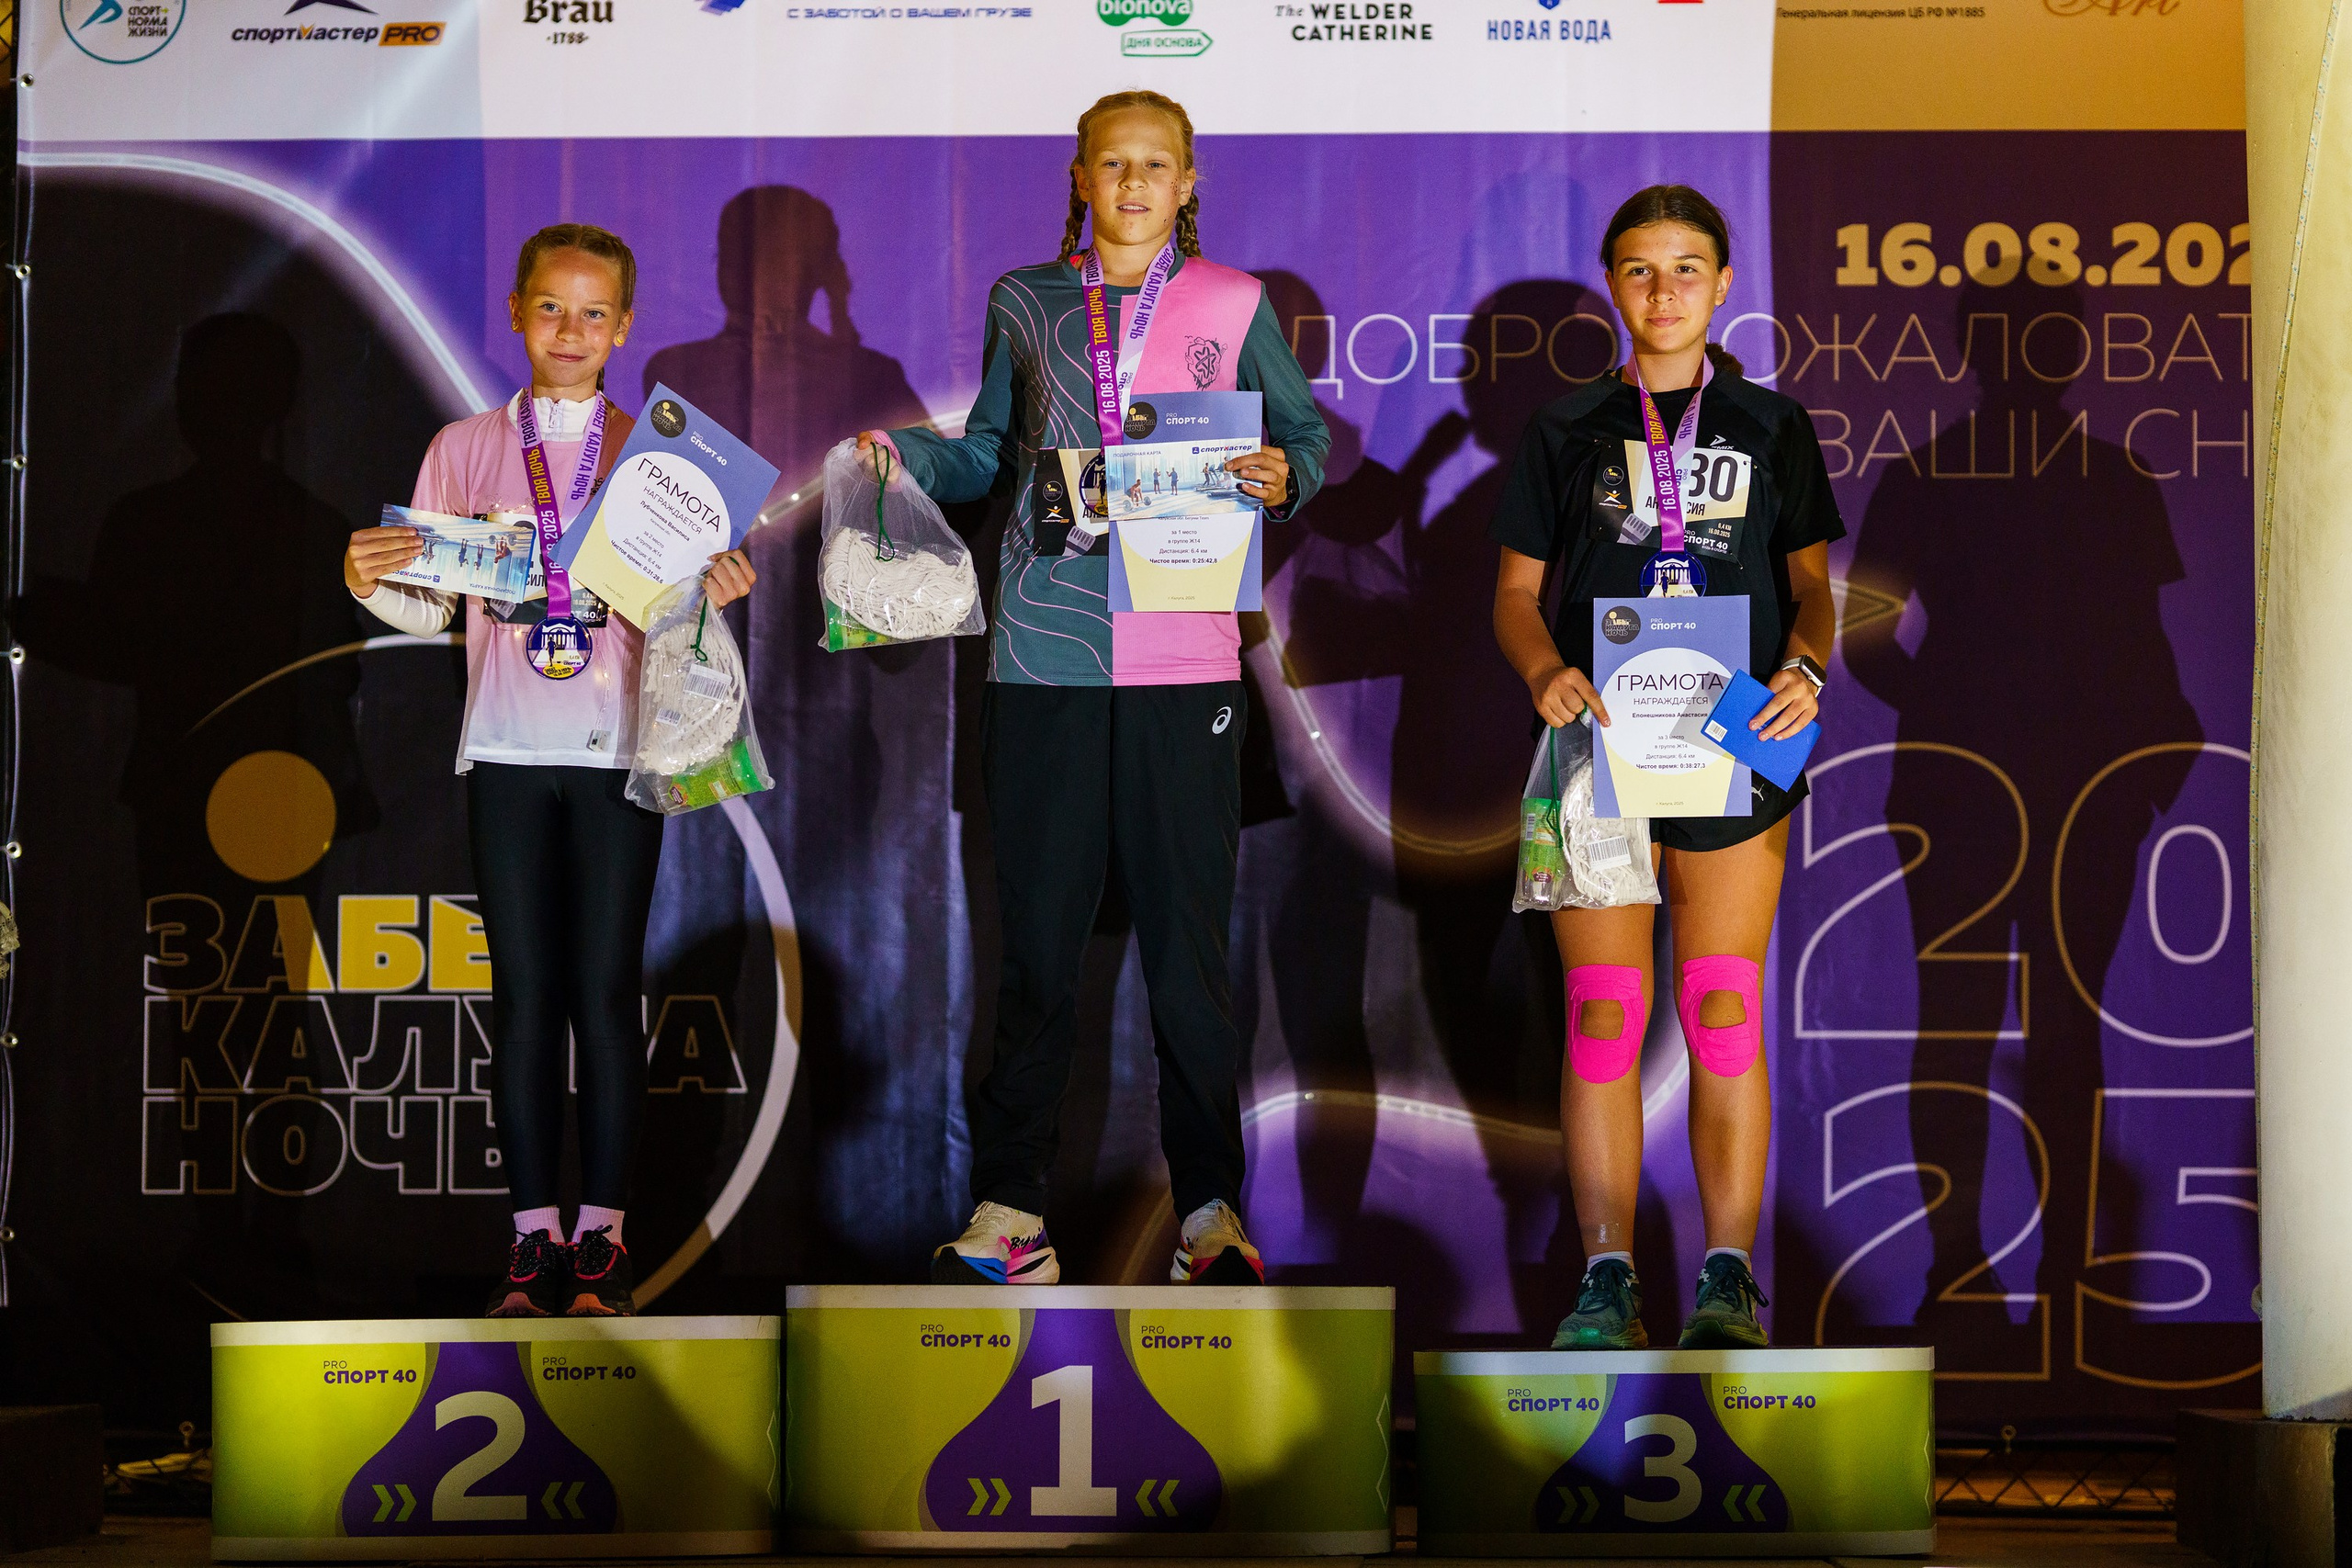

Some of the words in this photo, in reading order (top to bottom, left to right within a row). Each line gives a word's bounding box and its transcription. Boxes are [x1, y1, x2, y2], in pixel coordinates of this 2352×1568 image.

[128, 6, 161, 16] СПОРТ
[787, 8, 799, 18] С
[805, 6, 886, 18] ЗАБОТОЙ
[890, 8, 904, 18] О
[907, 7, 969, 18] ВАШЕМ
[975, 7, 1033, 17] ГРУЗЕ
[1100, 0, 1192, 15] bionova
[1274, 5, 1303, 17] The
[1311, 4, 1413, 19] WELDER
[1777, 7, 1849, 19] Генеральная
[1851, 8, 1905, 18] лицензия
[1908, 7, 1925, 18] ЦБ
[1927, 7, 1944, 17] РФ
[128, 17, 167, 26] НОРМА
[1487, 20, 1551, 40] НОВАЯ
[1560, 19, 1611, 43] ВОДА
[128, 27, 167, 37] ЖИЗНИ
[384, 26, 441, 42] PRO
[1292, 24, 1432, 40] CATHERINE
[1126, 38, 1151, 48] ДНЯ
[1154, 38, 1204, 47] ОСНОВА
[1154, 248, 1174, 273] ЗАБЕГ
[1085, 263, 1101, 284] ТВОЯ
[1139, 272, 1164, 310] КАЛУГА
[1091, 317, 1108, 345] ТВОЯ
[1129, 311, 1150, 339] НОЧЬ
[1291, 313, 1619, 400] ДОБРО
[1721, 312, 2252, 383] ОЖАЛОВАТ
[1096, 350, 1117, 413] 16.08.2025
[1166, 417, 1196, 425] СПОРТ
[1678, 413, 1695, 439] НОЧЬ
[521, 420, 537, 446] ТВОЯ
[693, 431, 704, 441] PRO
[1649, 420, 1666, 446] ТВОЯ
[579, 431, 603, 472] КАЛУГА
[690, 436, 718, 458] СПОРТ
[717, 456, 728, 466] 40
[1806, 408, 2087, 480] ВАШИ
[2124, 408, 2250, 480] СН
[571, 473, 591, 501] НОЧЬ
[1654, 449, 1677, 511] 16.08.2025
[534, 478, 552, 505] ТВОЯ
[638, 457, 720, 533] ГРАМОТА
[643, 486, 703, 535] НАГРАЖДАЕТСЯ
[667, 521, 691, 541] Василиса
[639, 538, 652, 550] группе
[652, 548, 662, 558] Ж14
[652, 536, 665, 548] место
[1683, 536, 1715, 547] СПОРТ
[1716, 541, 1728, 550] 40
[610, 539, 628, 556] Чистое
[627, 554, 644, 568] время:
[582, 611, 596, 619] 40
[1684, 622, 1696, 630] 40
[1617, 673, 1724, 691] ГРАМОТА
[1634, 696, 1709, 705] НАГРАЖДАЕТСЯ
[1795, 742, 2256, 1047] 20
[143, 895, 493, 994] ЗАБЕ
[143, 995, 748, 1094] КАЛА
[141, 1094, 511, 1195] НОЧЬ
[1815, 1080, 2262, 1389] 25
[921, 1324, 944, 1333] PRO
[1141, 1325, 1165, 1335] PRO
[921, 1334, 984, 1348] СПОРТ
[988, 1334, 1012, 1348] 40
[1141, 1336, 1205, 1348] СПОРТ
[1208, 1336, 1233, 1349] 40
[323, 1360, 347, 1369] PRO
[542, 1357, 567, 1366] PRO
[323, 1370, 389, 1384] СПОРТ
[392, 1369, 417, 1383] 40
[543, 1366, 608, 1381] СПОРТ
[612, 1366, 637, 1380] 40
[1508, 1388, 1532, 1397] PRO
[1723, 1386, 1747, 1394] PRO
[1508, 1398, 1572, 1412] СПОРТ
[1576, 1397, 1600, 1411] 40
[1724, 1395, 1788, 1409] СПОРТ
[1792, 1394, 1816, 1409] 40
[1031, 1365, 1117, 1517] 1
[432, 1391, 527, 1522] 2
[1624, 1414, 1702, 1523] 3
